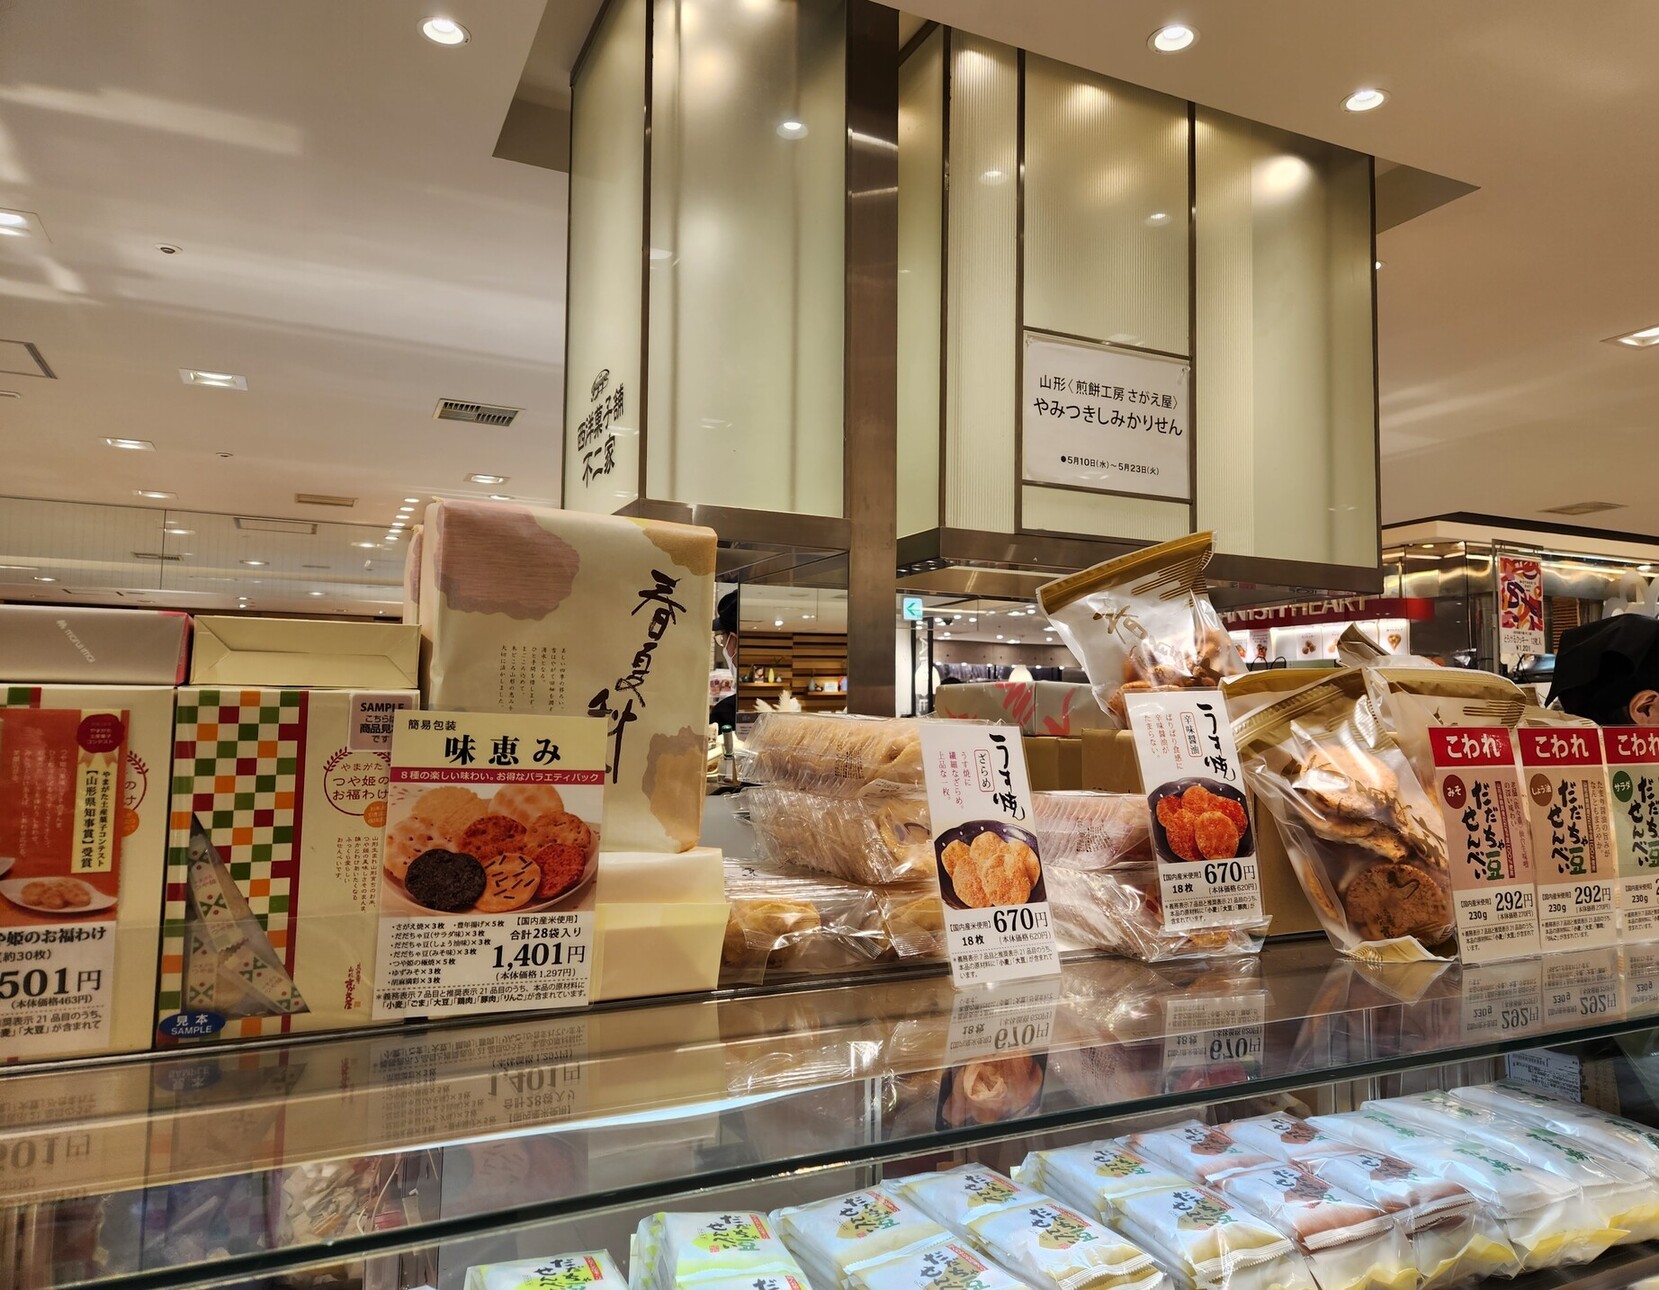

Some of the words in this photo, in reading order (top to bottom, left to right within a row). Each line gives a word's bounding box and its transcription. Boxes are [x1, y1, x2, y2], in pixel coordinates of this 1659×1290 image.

[1128, 388, 1178, 410] さがえ屋〉
[1034, 397, 1183, 436] やみつきしみかりせん
[582, 433, 616, 488] 不二家
[408, 719, 457, 731] 簡易包装
[371, 734, 389, 743] です
[1446, 733, 1502, 759] こわれ
[1535, 733, 1590, 759] こわれ
[445, 734, 561, 766] 味恵み
[341, 762, 383, 772] やまがた
[960, 751, 971, 787] うす焼に
[978, 752, 992, 790] ざらめ
[332, 775, 390, 787] つや姫の
[401, 770, 599, 783] 8種の楽しい味わい。お得なバラエティパック
[332, 788, 389, 800] お福わけ
[1447, 785, 1462, 798] みそ
[1532, 781, 1552, 796] しょう油
[1614, 780, 1631, 791] サラダ
[81, 770, 99, 868] 【山形県知事賞】受賞
[1558, 779, 1590, 876] だだちゃ豆
[1471, 780, 1505, 881] だだちゃ豆
[1547, 803, 1572, 874] せんべい
[1628, 799, 1651, 867] せんべい
[1461, 805, 1488, 880] せんべい
[1204, 861, 1255, 885] 670円
[1172, 883, 1193, 893] 18枚
[1574, 885, 1611, 905] 292円
[1495, 890, 1533, 911] 292円
[1632, 894, 1649, 904] 230g
[1468, 911, 1488, 921] 230g
[1548, 903, 1567, 913] 230g
[516, 914, 578, 926] 【国内産米使用】
[993, 907, 1048, 933] 670円
[510, 927, 581, 940] 合計28袋入り
[962, 934, 985, 946] 18枚
[492, 942, 586, 971] 1,401円
[959, 971, 978, 979] います。
[177, 1014, 208, 1026] 見本
[171, 1025, 212, 1035] SAMPLE
